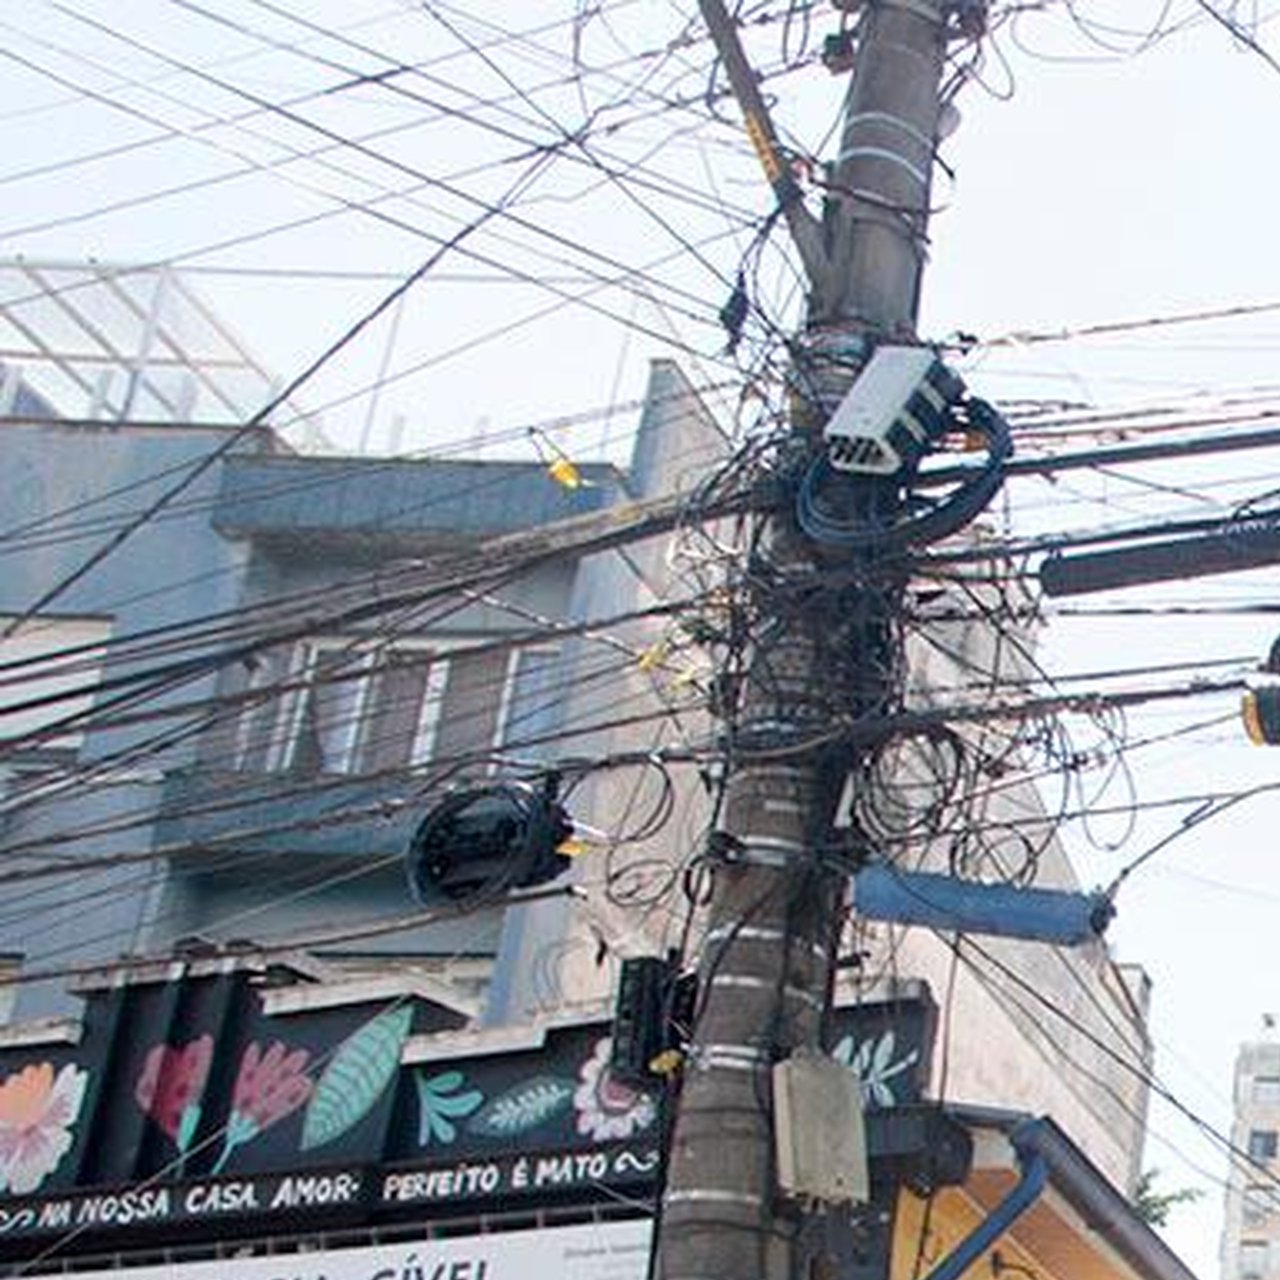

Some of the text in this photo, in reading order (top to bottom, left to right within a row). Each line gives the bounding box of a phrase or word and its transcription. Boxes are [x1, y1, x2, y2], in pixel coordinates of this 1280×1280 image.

[78, 1189, 169, 1225] NOSSA
[186, 1184, 258, 1213] CASA
[535, 1154, 606, 1185] MATO
